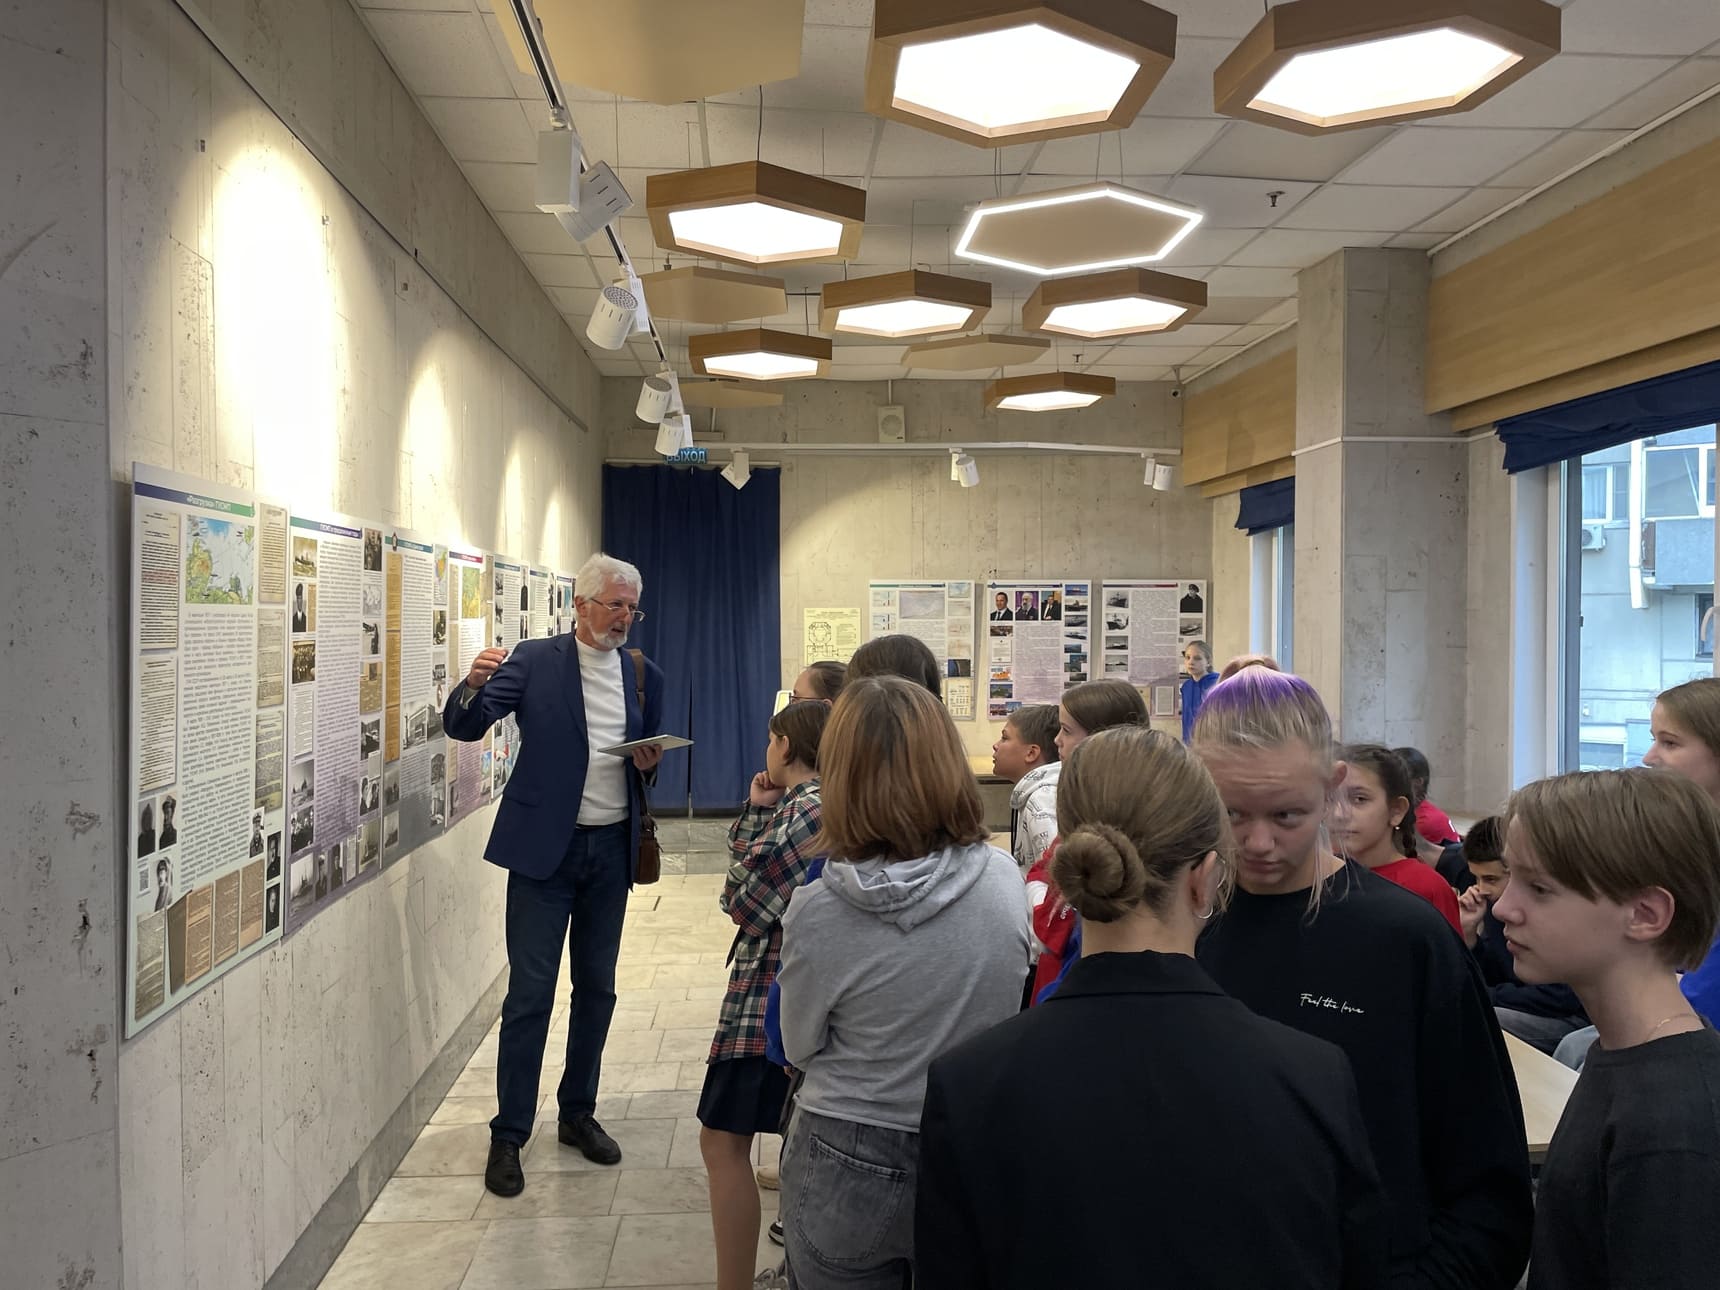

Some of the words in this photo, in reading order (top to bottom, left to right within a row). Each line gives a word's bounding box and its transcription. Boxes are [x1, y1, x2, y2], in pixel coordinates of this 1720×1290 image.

[666, 450, 706, 463] ВЫХОД
[1300, 993, 1322, 1006] Feel
[1323, 997, 1338, 1008] the
[1341, 1001, 1364, 1013] love
